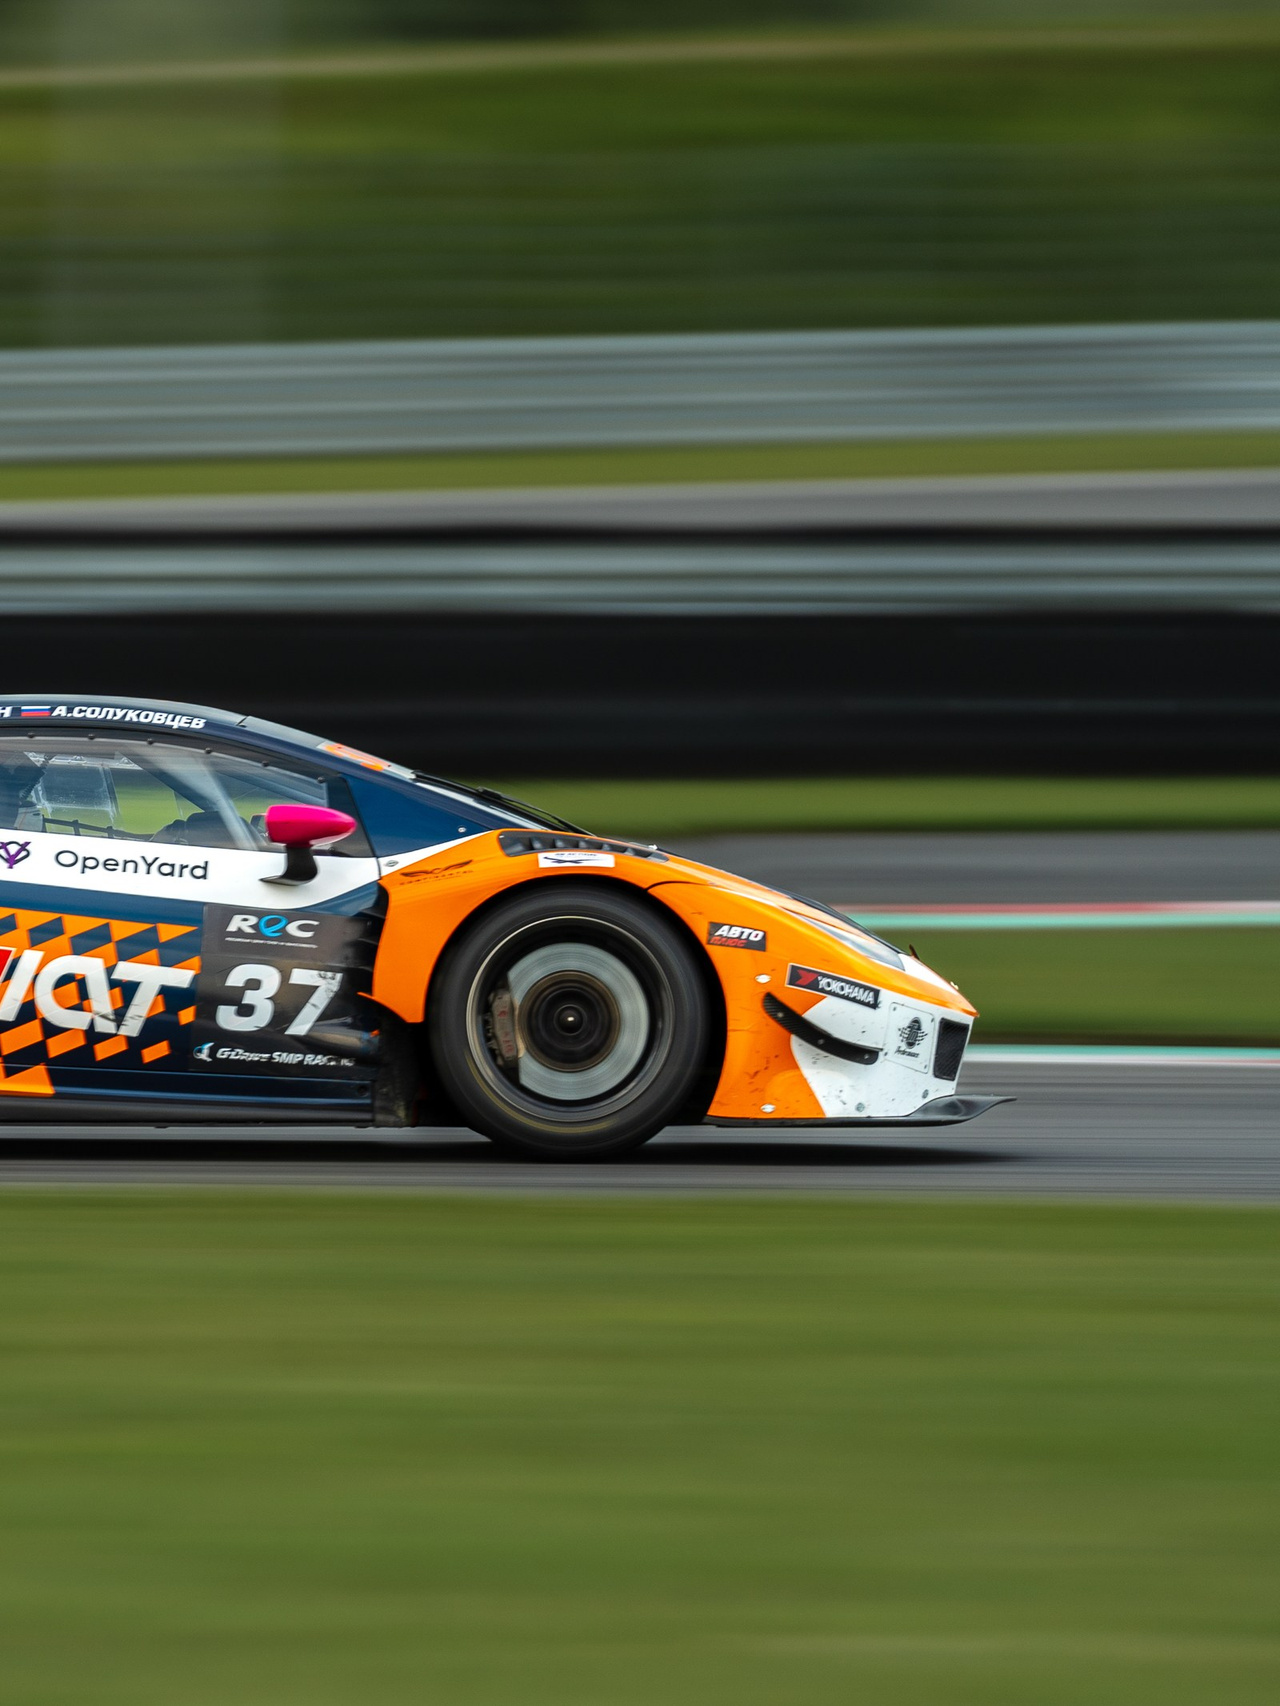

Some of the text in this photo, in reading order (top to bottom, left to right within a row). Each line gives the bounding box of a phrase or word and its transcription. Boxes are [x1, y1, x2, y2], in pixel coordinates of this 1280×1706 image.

[51, 705, 207, 729] А.СОЛУКОВЦЕВ
[54, 849, 209, 880] OpenYard
[714, 925, 765, 942] АВТО
[216, 963, 343, 1036] 37
[818, 975, 875, 1005] YOKOHAMA
[271, 1051, 303, 1065] SMP
